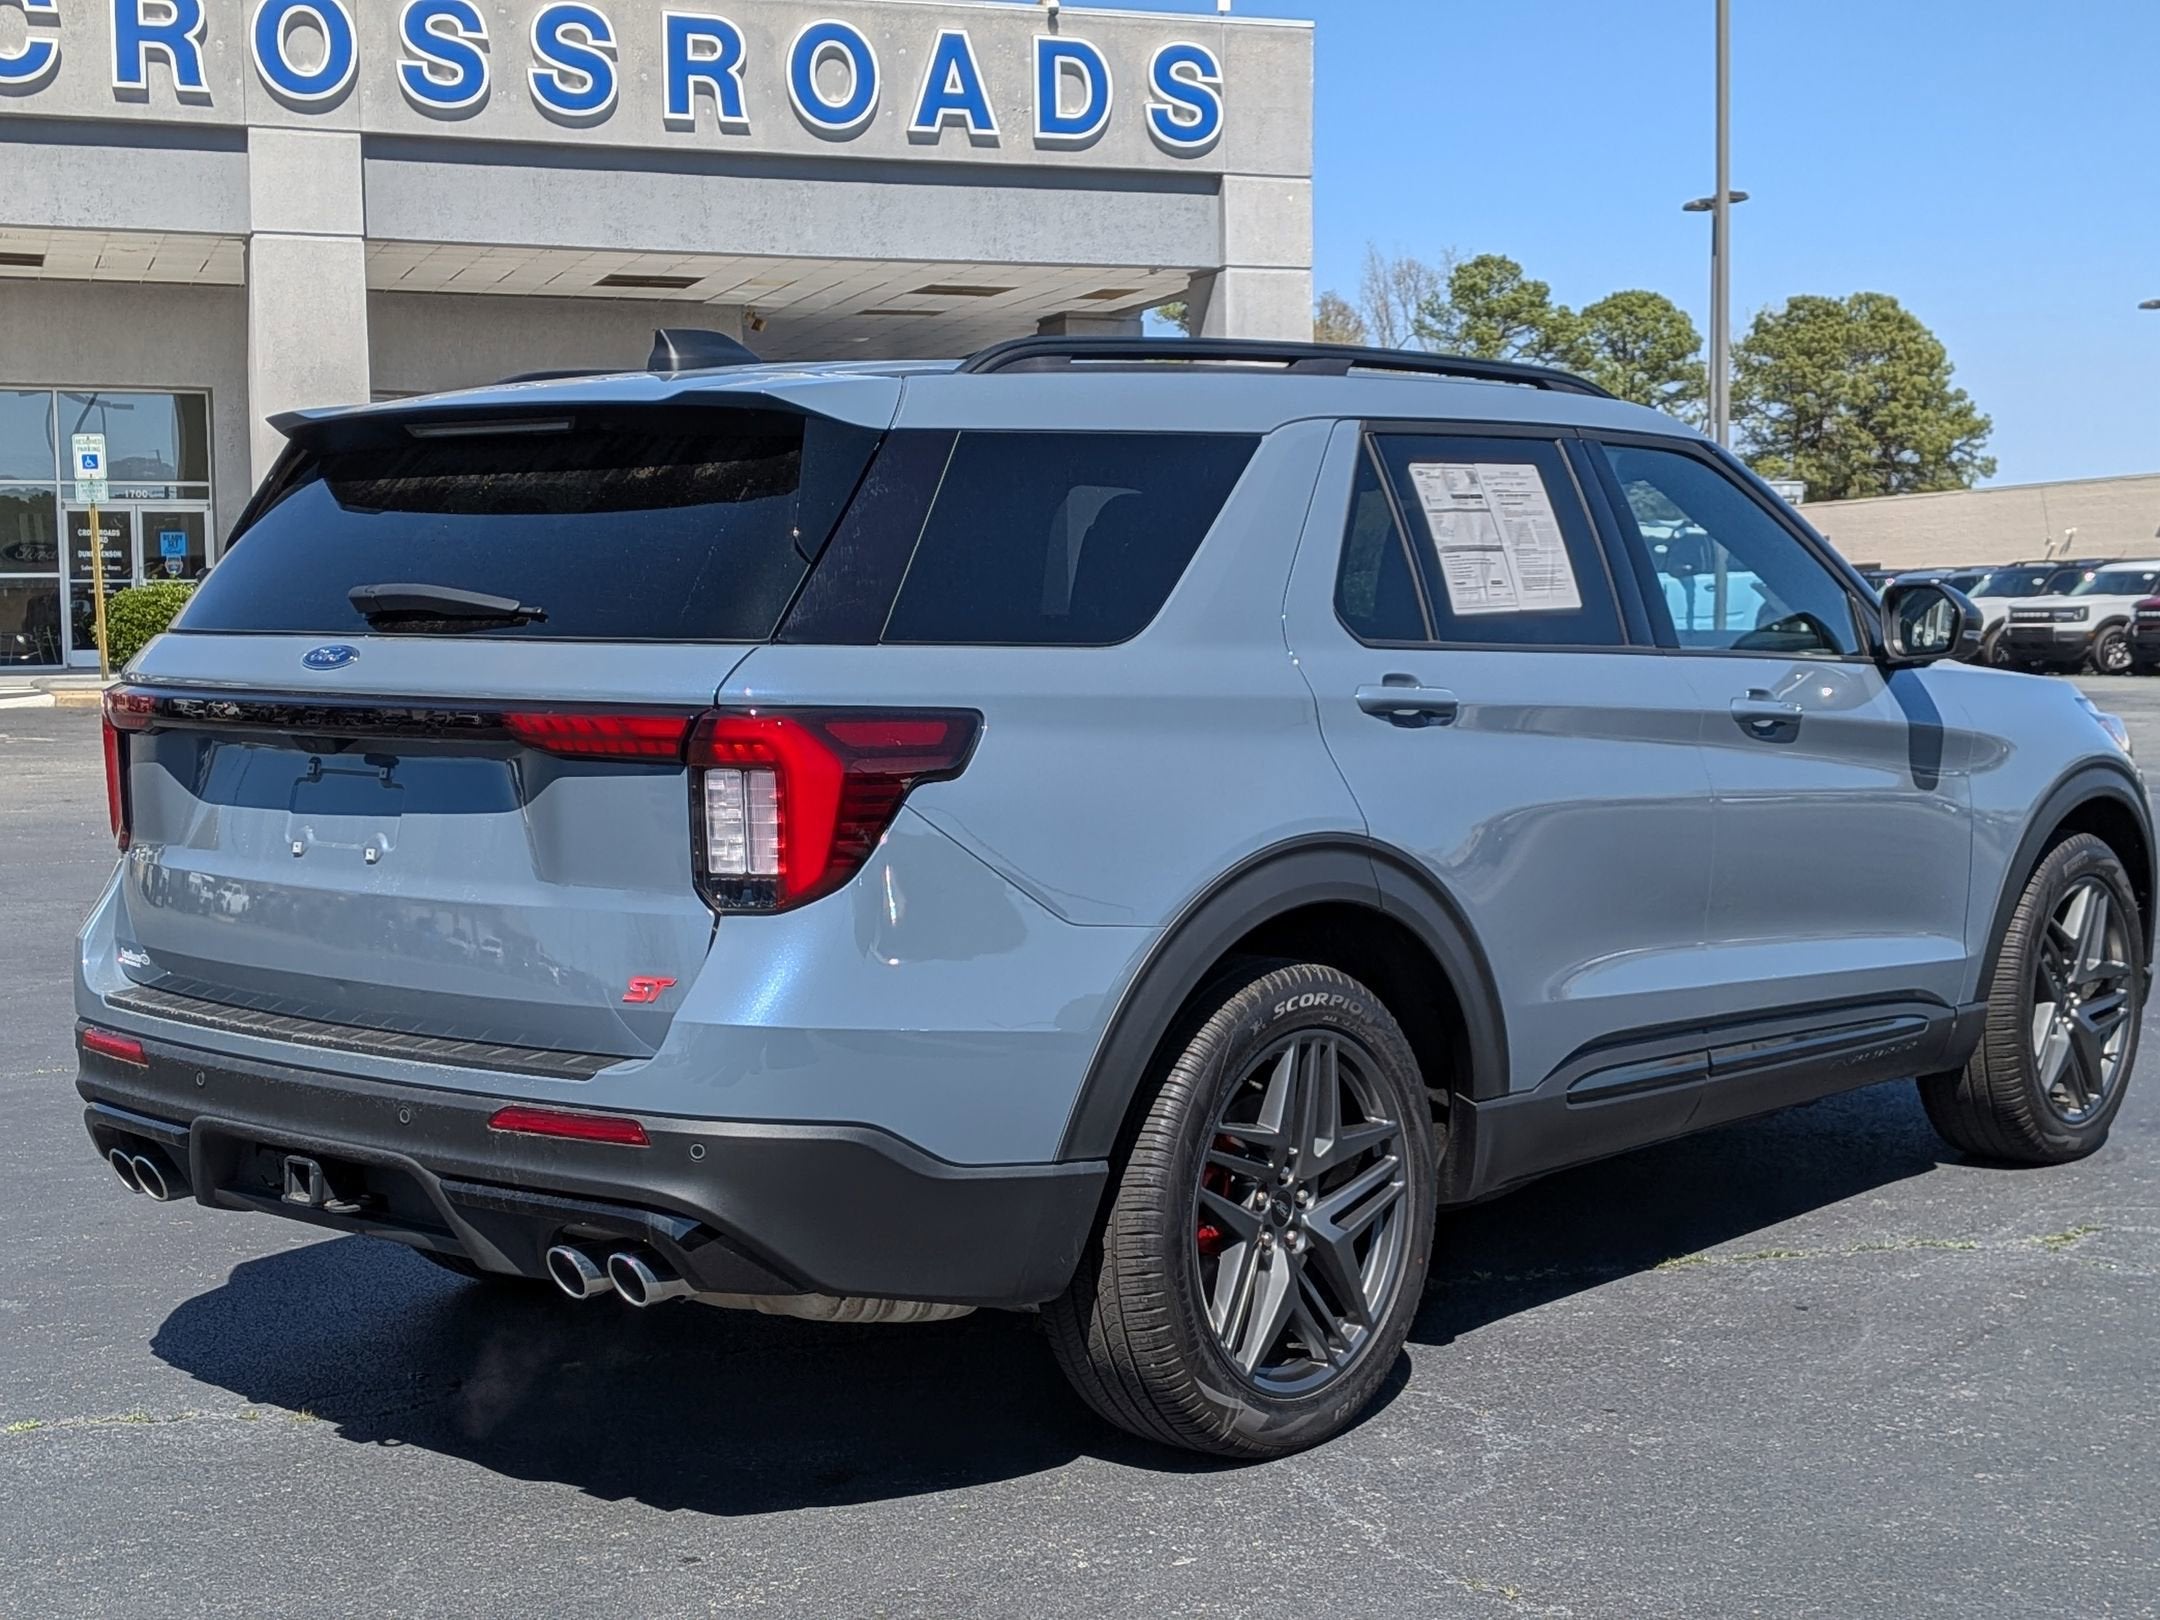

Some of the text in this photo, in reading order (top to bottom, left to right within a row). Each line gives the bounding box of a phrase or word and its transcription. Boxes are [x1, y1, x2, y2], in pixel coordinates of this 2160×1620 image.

[124, 489, 148, 498] 1700
[78, 528, 120, 537] CROROADS
[622, 976, 678, 1003] ST
